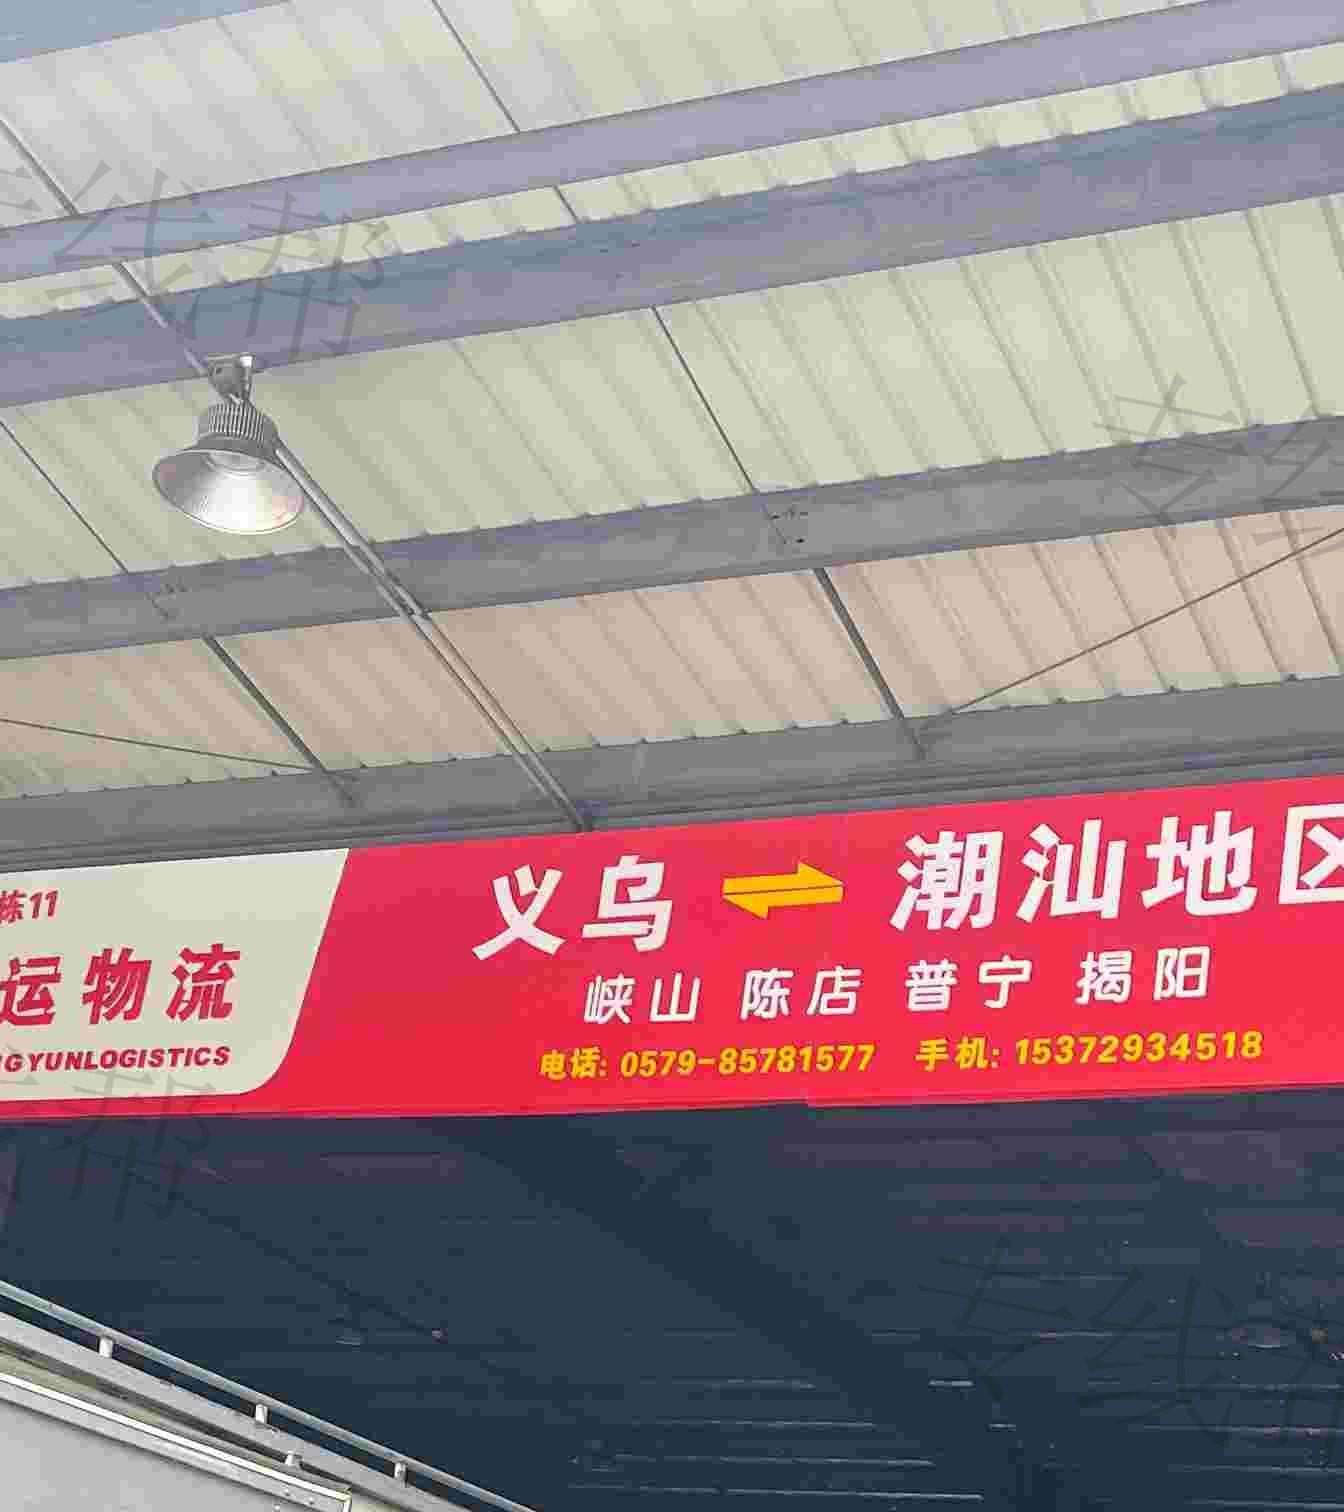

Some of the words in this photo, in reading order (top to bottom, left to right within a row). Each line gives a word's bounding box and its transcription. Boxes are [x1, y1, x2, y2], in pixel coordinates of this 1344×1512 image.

[473, 854, 675, 961] 义乌
[582, 972, 701, 1026] 峡山
[739, 966, 862, 1020] 陈店
[904, 956, 1032, 1013] 普宁
[1076, 945, 1212, 1004] 揭阳
[619, 1043, 876, 1079] 0579-85781577
[1014, 1030, 1264, 1067] 15372934518
